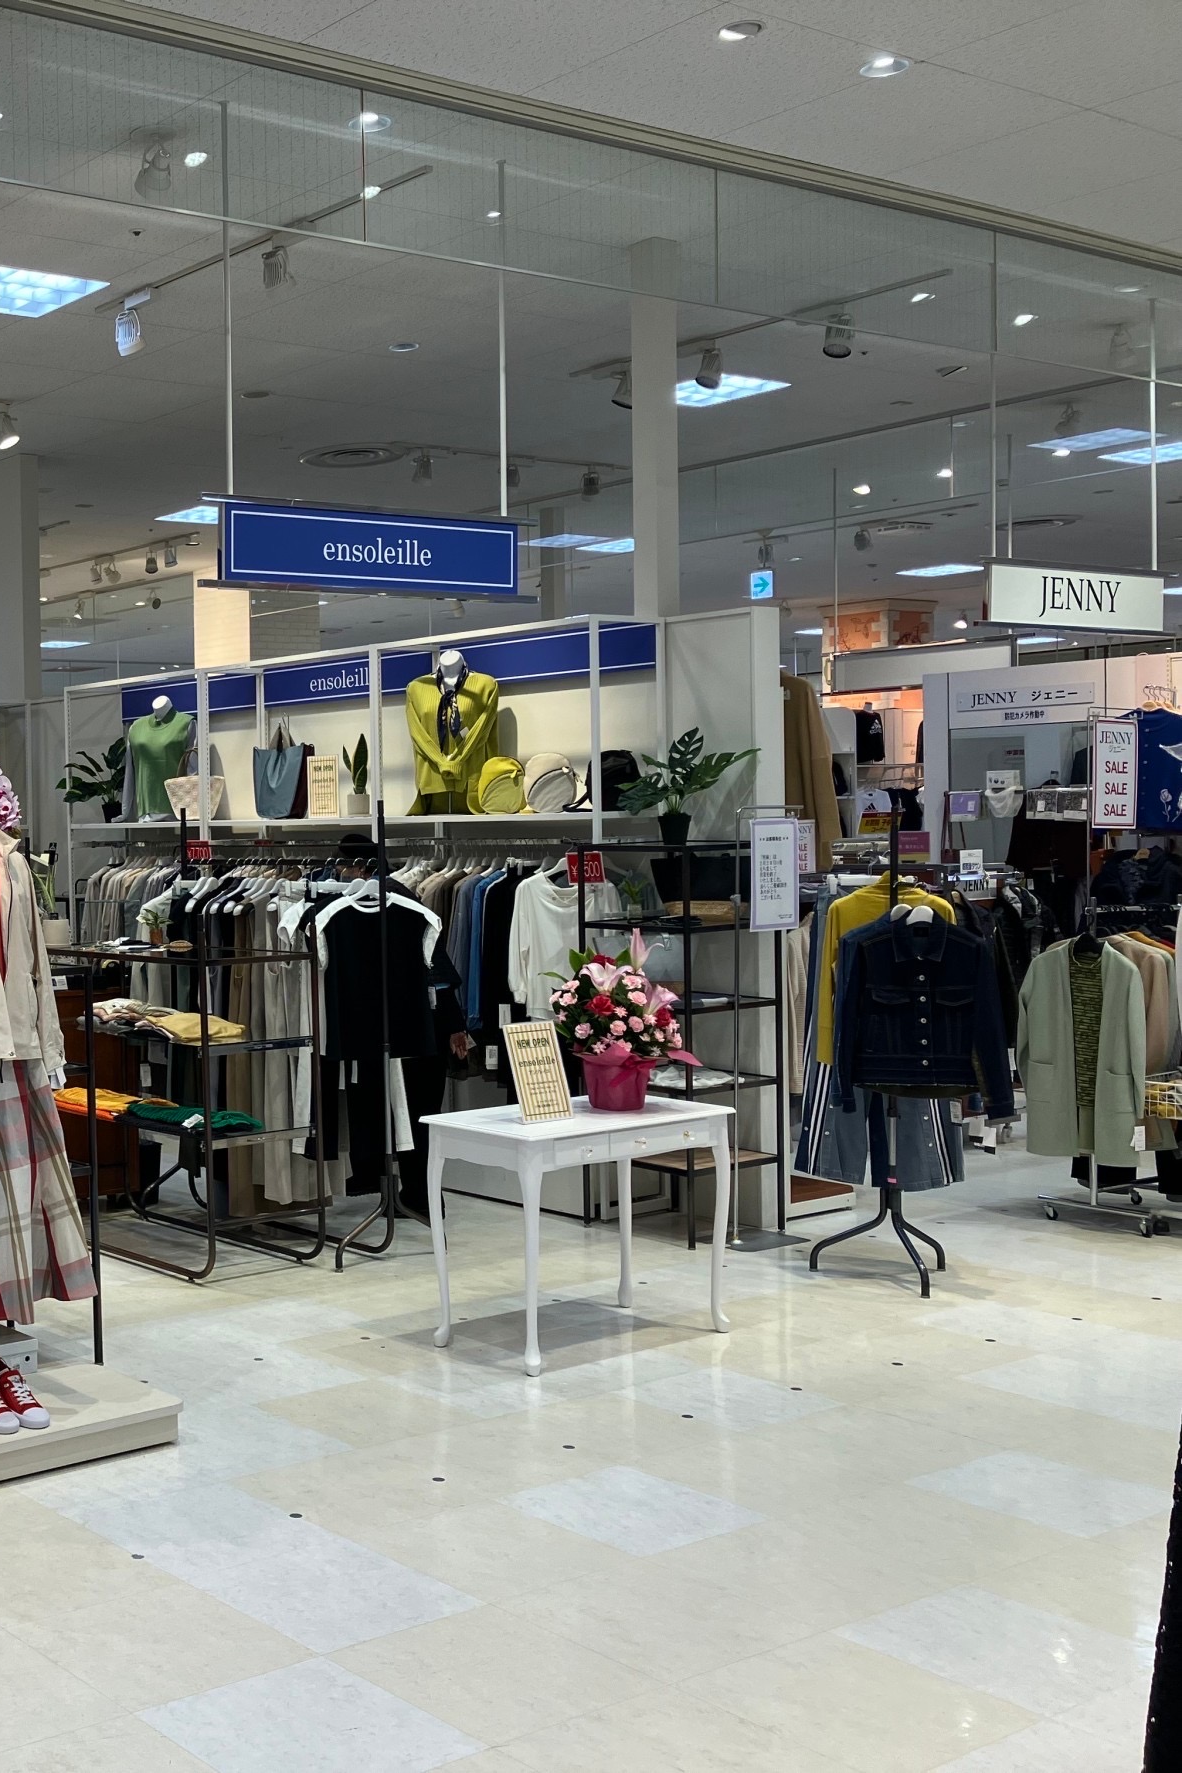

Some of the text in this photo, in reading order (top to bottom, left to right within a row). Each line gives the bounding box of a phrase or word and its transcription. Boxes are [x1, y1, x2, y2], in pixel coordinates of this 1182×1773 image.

[323, 537, 432, 567] ensoleille
[1039, 575, 1122, 617] JENNY
[309, 667, 369, 692] ensoleill
[971, 690, 1078, 708] JENNY ジェニー
[1099, 731, 1133, 745] JENNY
[1105, 761, 1128, 774] SALE
[1104, 782, 1128, 795] SALE
[1103, 804, 1127, 816] SALE
[516, 1037, 549, 1048] NEW OPEN
